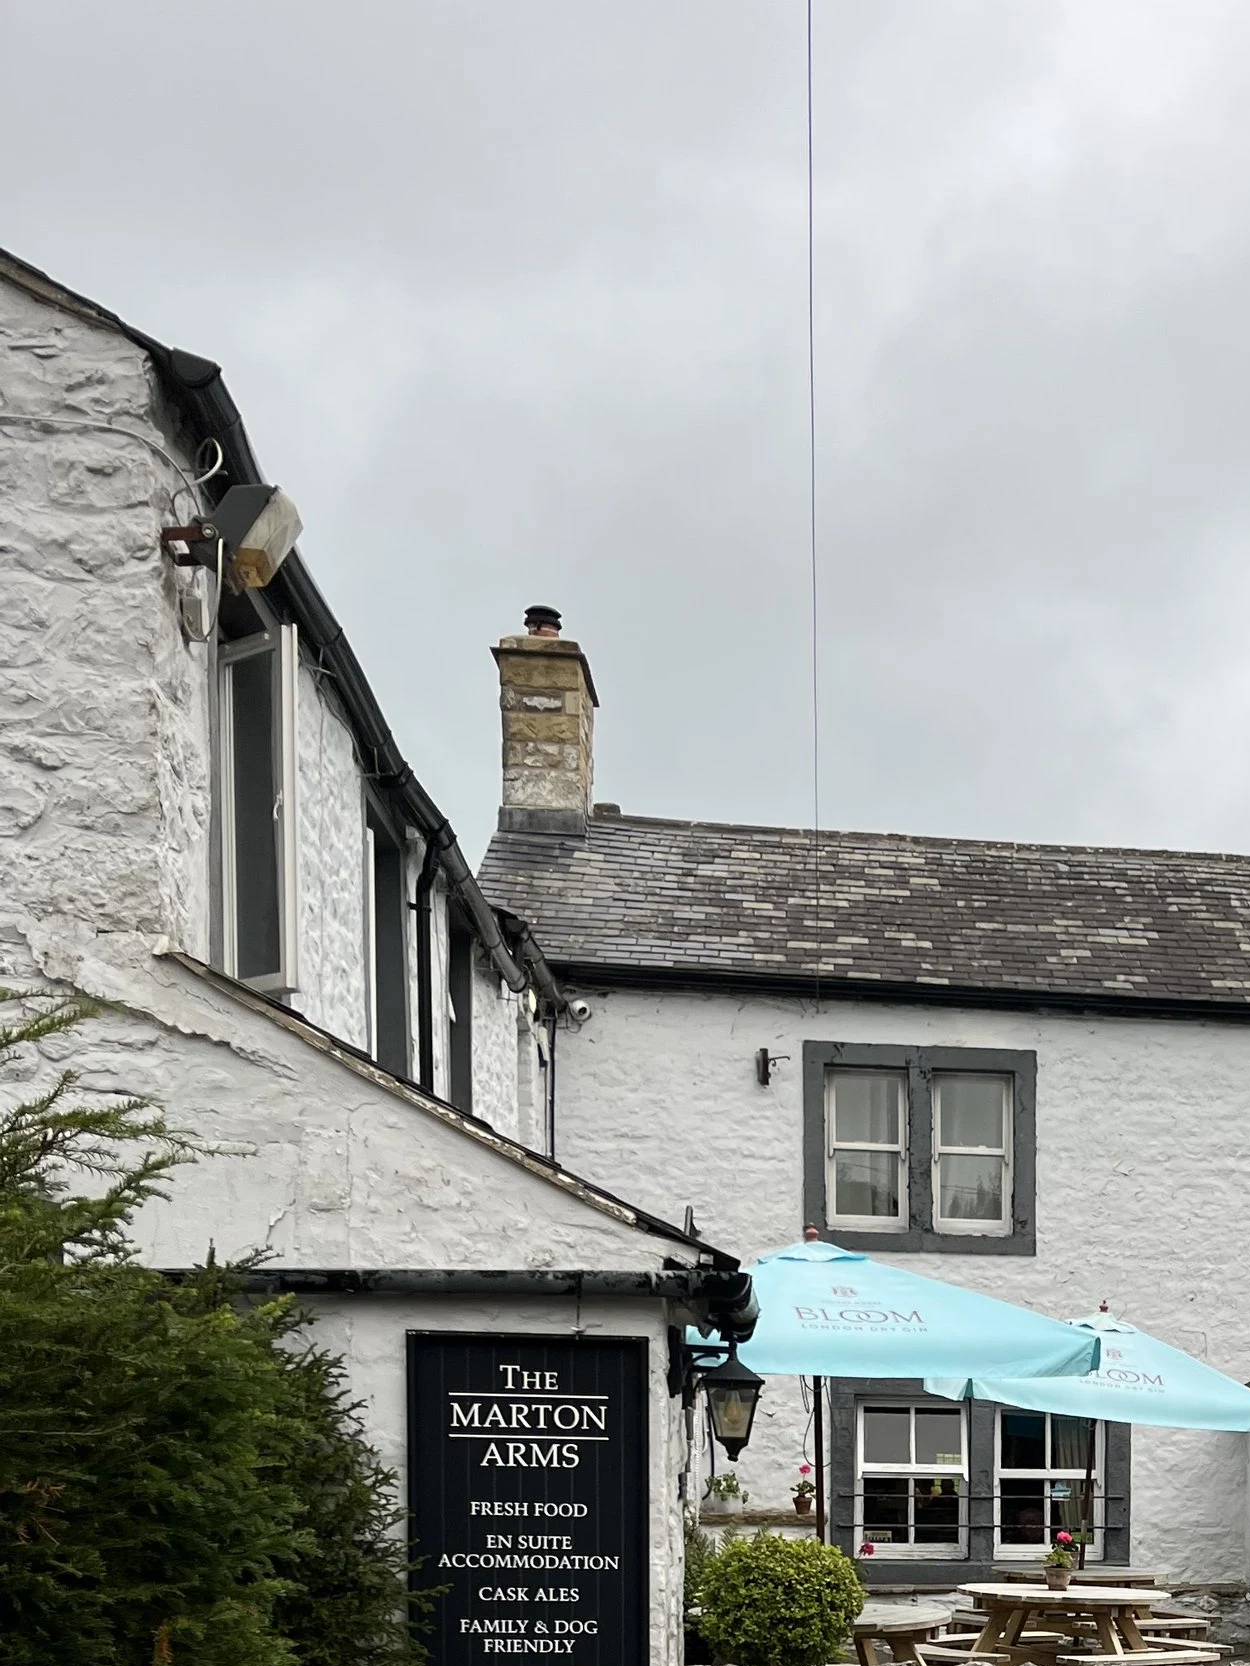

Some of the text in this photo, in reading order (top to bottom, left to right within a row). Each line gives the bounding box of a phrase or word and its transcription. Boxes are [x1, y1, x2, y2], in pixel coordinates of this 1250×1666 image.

[792, 1306, 925, 1324] BLOOM
[449, 1402, 608, 1431] MARTON
[480, 1442, 581, 1469] ARMS
[470, 1501, 588, 1518] FRESH FOOD
[486, 1535, 572, 1550] EN SUITE
[438, 1553, 620, 1571] ACCOMMODATION
[478, 1587, 580, 1602] CASK ALES
[459, 1619, 598, 1635] FAMILY & DOG
[483, 1638, 576, 1655] FRIENDLY
